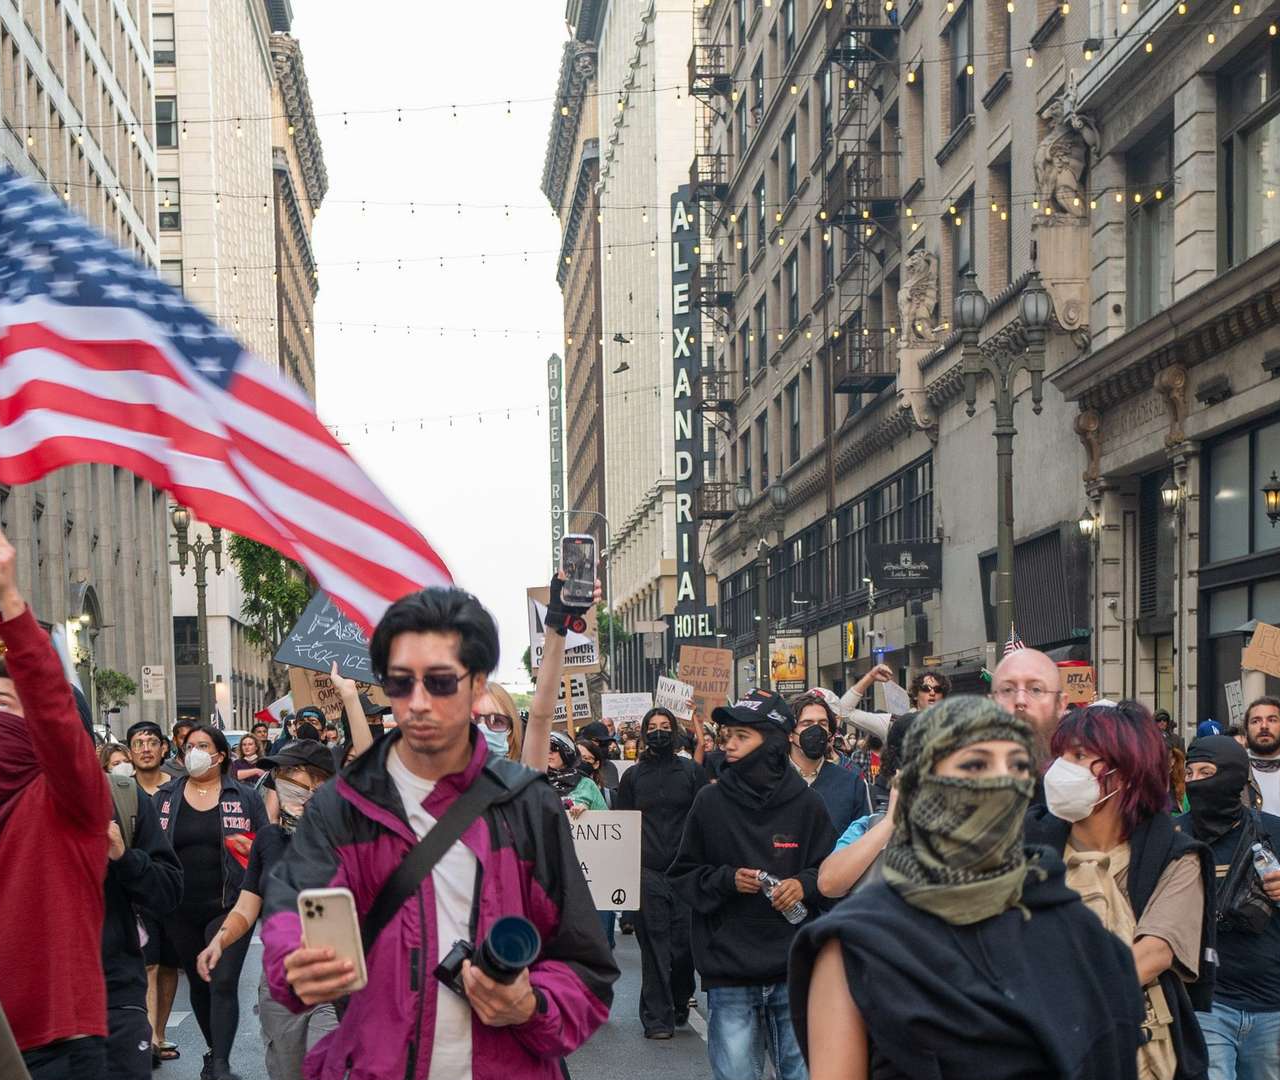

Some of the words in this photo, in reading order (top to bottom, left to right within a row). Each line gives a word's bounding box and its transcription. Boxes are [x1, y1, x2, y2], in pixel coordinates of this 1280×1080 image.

[549, 364, 559, 462] HOTEL
[672, 201, 695, 600] ALEXANDRIA
[674, 613, 713, 638] HOTEL
[295, 643, 339, 666] FUCK
[342, 653, 371, 671] ICE
[659, 680, 676, 694] VIVA
[1066, 672, 1092, 683] DTLA
